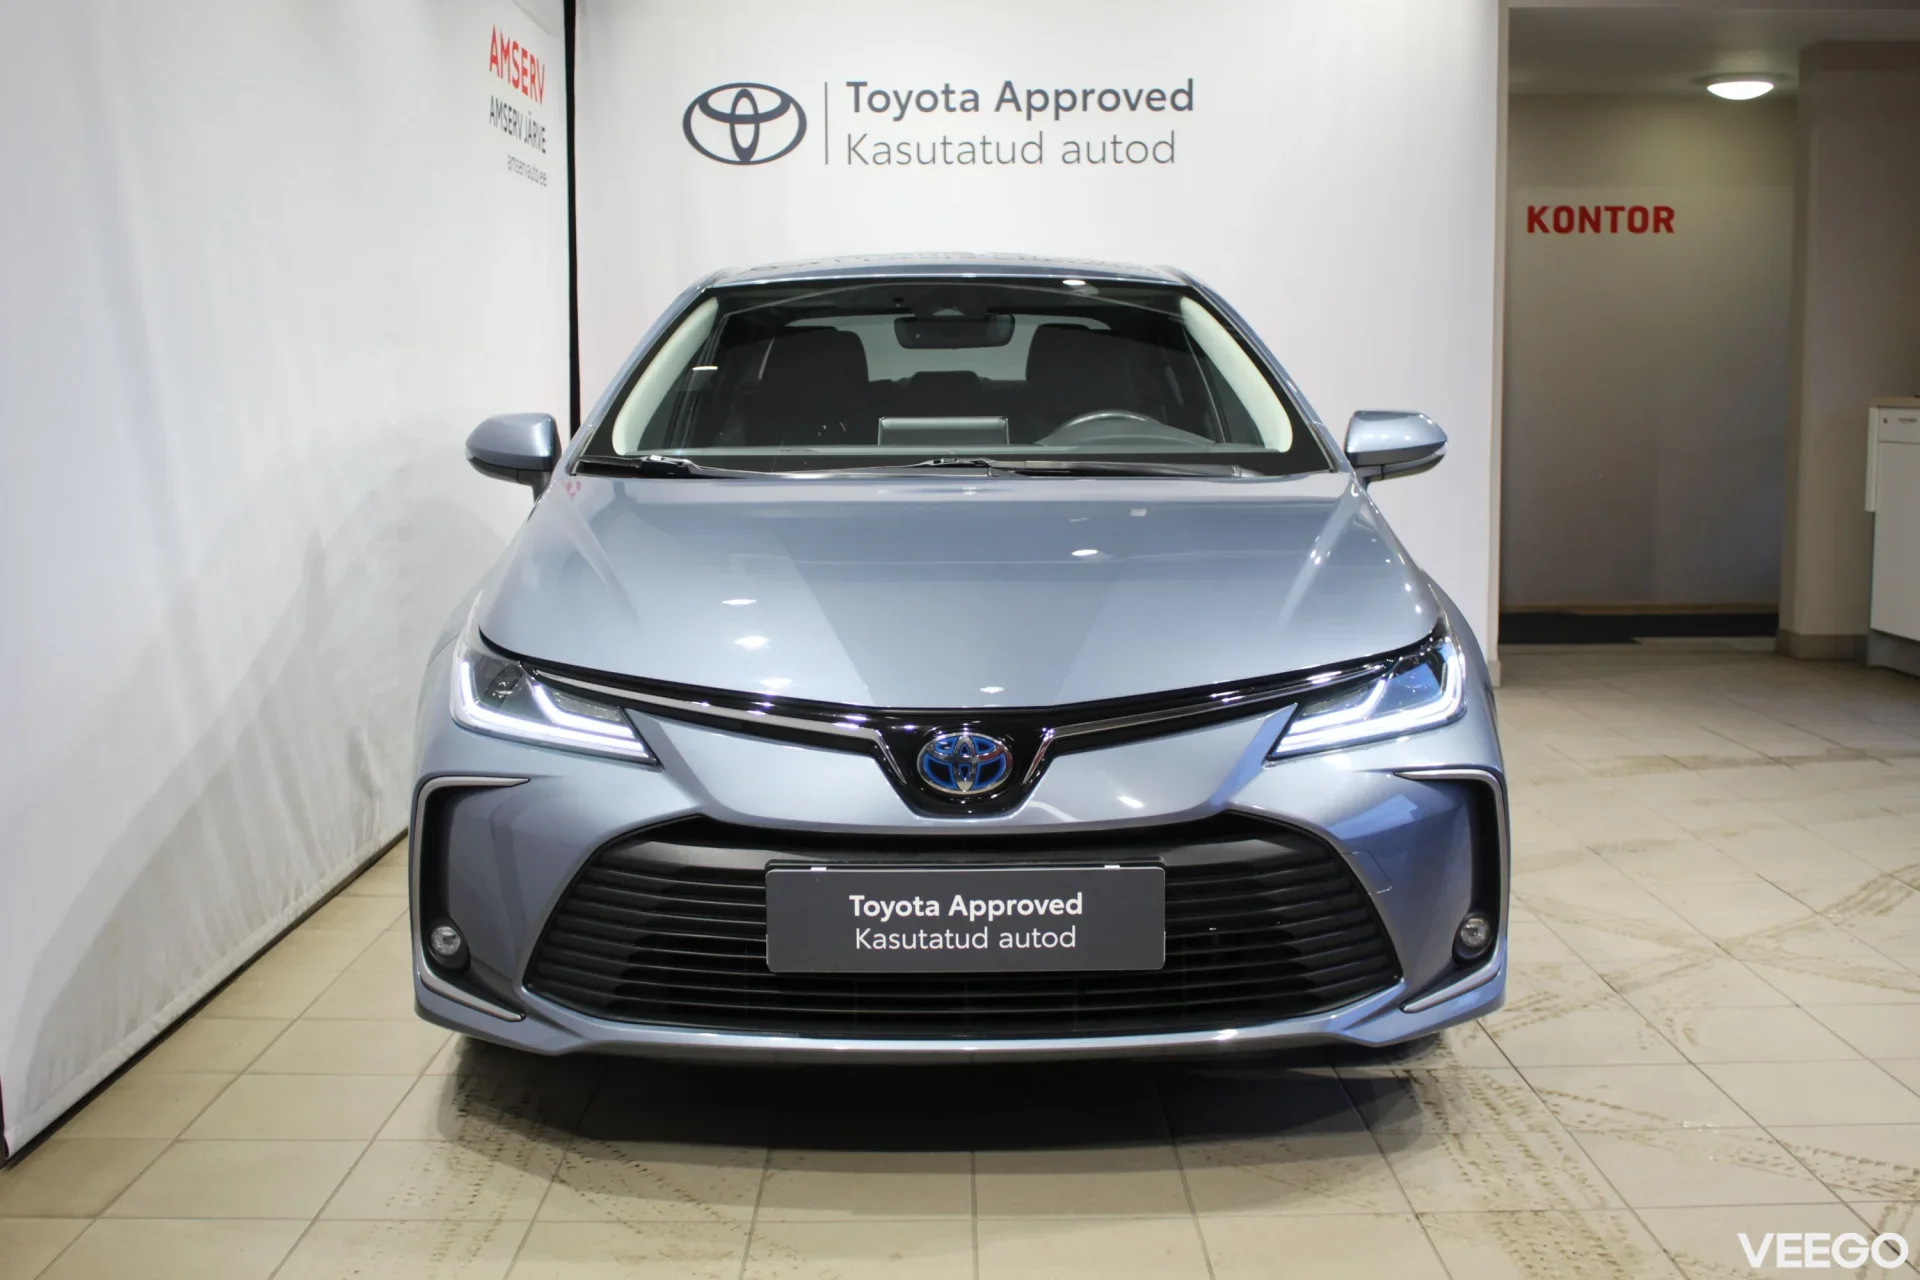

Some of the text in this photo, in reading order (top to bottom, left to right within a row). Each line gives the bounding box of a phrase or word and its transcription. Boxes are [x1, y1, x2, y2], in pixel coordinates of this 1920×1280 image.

[489, 24, 545, 105] AMSERV
[846, 78, 1194, 121] Toyota Approved
[489, 95, 547, 154] AMSERV JÄRVE
[847, 130, 1176, 165] Kasutatud autod
[1527, 205, 1675, 234] KONTOR
[849, 892, 1083, 922] Toyota Approved
[855, 925, 1076, 950] Kasutatud autod
